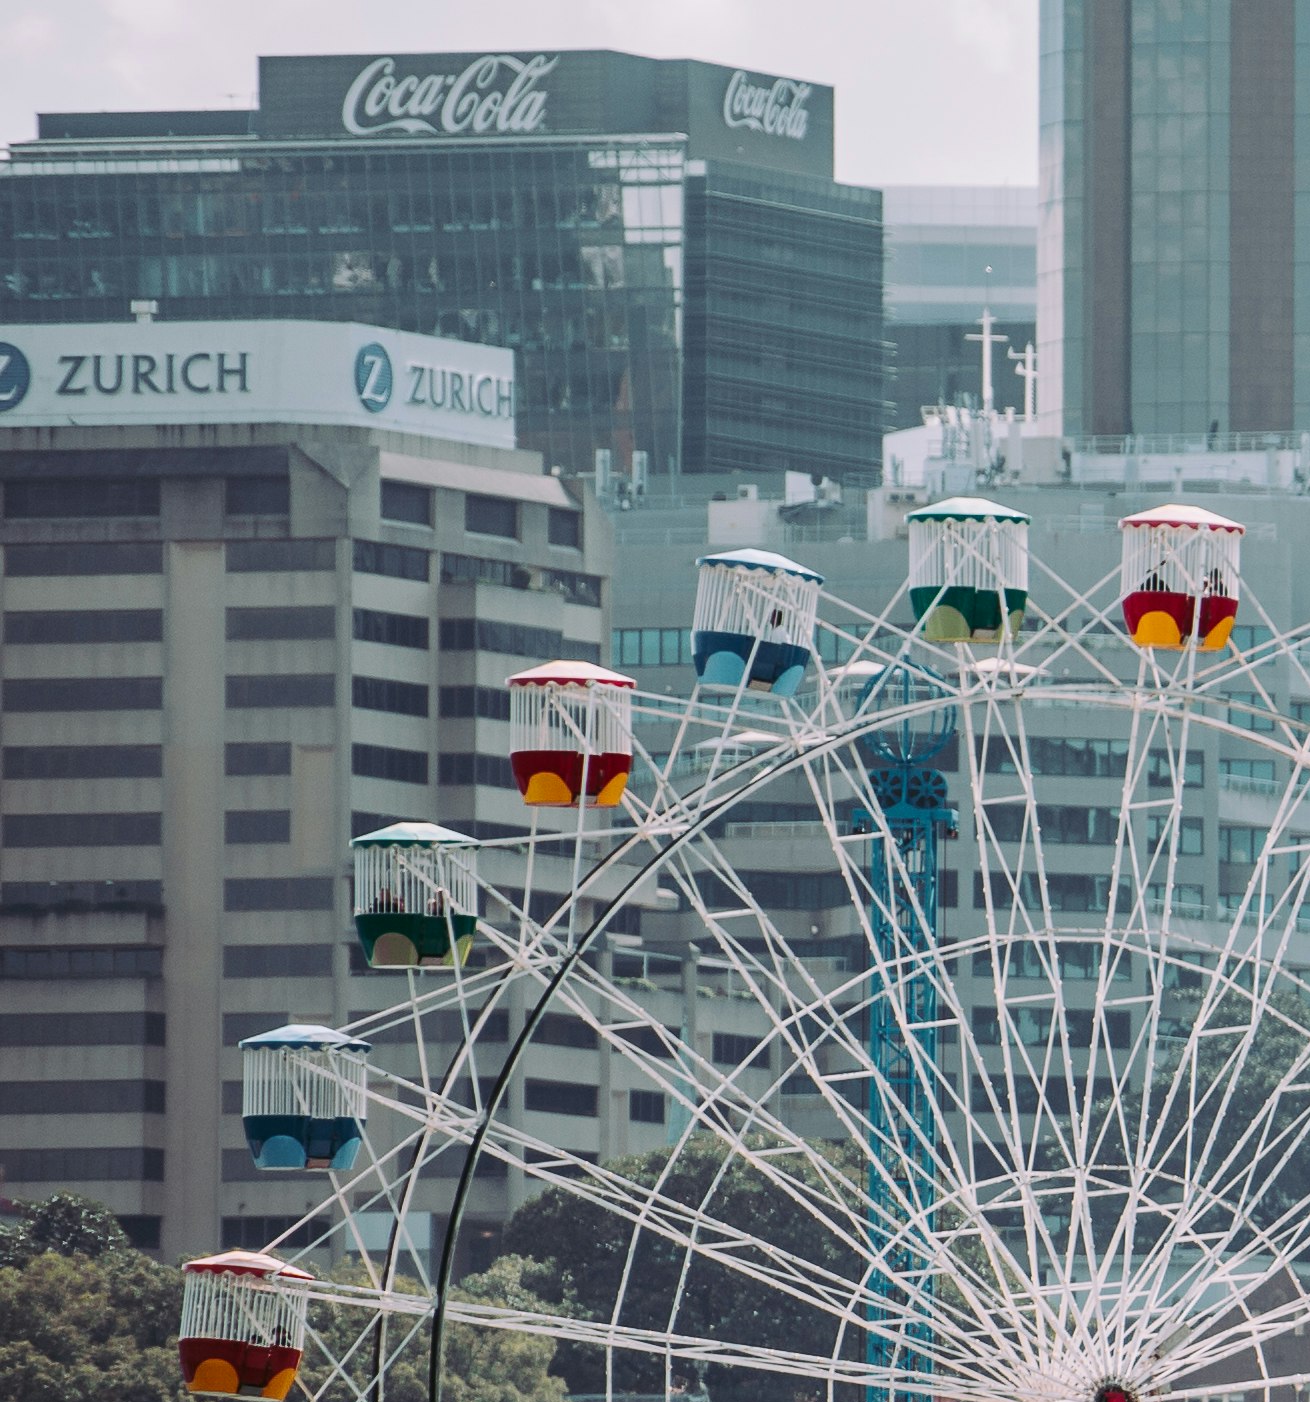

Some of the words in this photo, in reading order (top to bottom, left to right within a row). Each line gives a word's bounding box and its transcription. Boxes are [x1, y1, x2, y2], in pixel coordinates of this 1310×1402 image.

[342, 54, 559, 135] Coca-Cola
[724, 70, 813, 140] Coca-Cola
[57, 353, 251, 395] ZURICH
[406, 364, 515, 419] ZURICH
